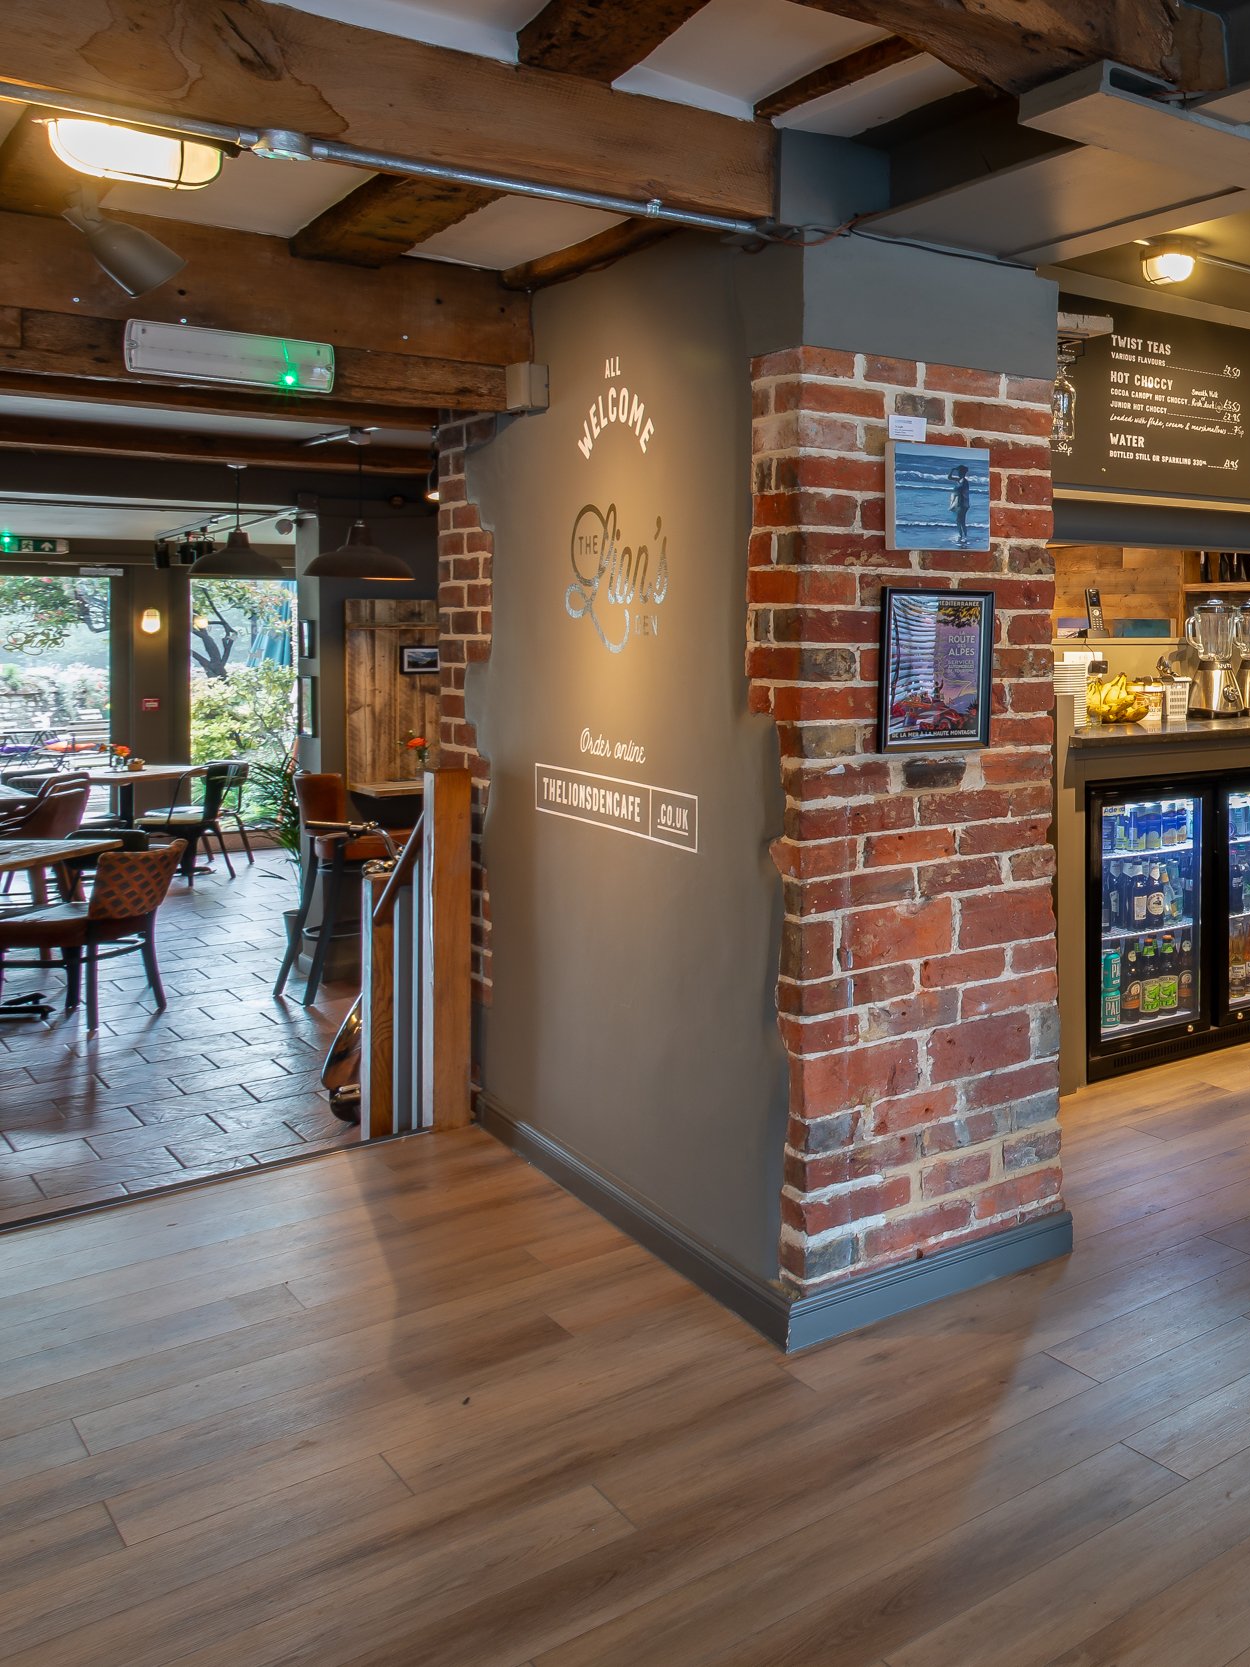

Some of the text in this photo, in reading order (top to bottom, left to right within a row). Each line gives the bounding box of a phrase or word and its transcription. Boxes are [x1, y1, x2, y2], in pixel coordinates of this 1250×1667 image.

[1111, 335, 1171, 356] TWIST TEAS
[605, 356, 620, 379] ALL
[1111, 352, 1166, 367] VARIOUS FLAVOURS
[1110, 371, 1173, 390] HOT CHOCCY
[1110, 388, 1188, 406] COCOA CANOPY HOT CHOCCY
[1110, 400, 1168, 415] JUNIOR HOT CHOCCY
[578, 387, 654, 459] WELCOME
[1110, 414, 1134, 422] Loaded
[1134, 417, 1146, 425] with
[1191, 425, 1226, 435] marshmallows
[1110, 433, 1145, 448] WATER
[1110, 450, 1191, 465] BOTTLED STILL OR SPARKLING
[578, 535, 598, 556] THE
[566, 503, 668, 654] Lion's
[949, 648, 975, 656] ALPES
[580, 727, 646, 764] Order online
[543, 777, 689, 830] THELIONSDENCAFE .CO.UK
[1106, 1001, 1120, 1016] PAL
